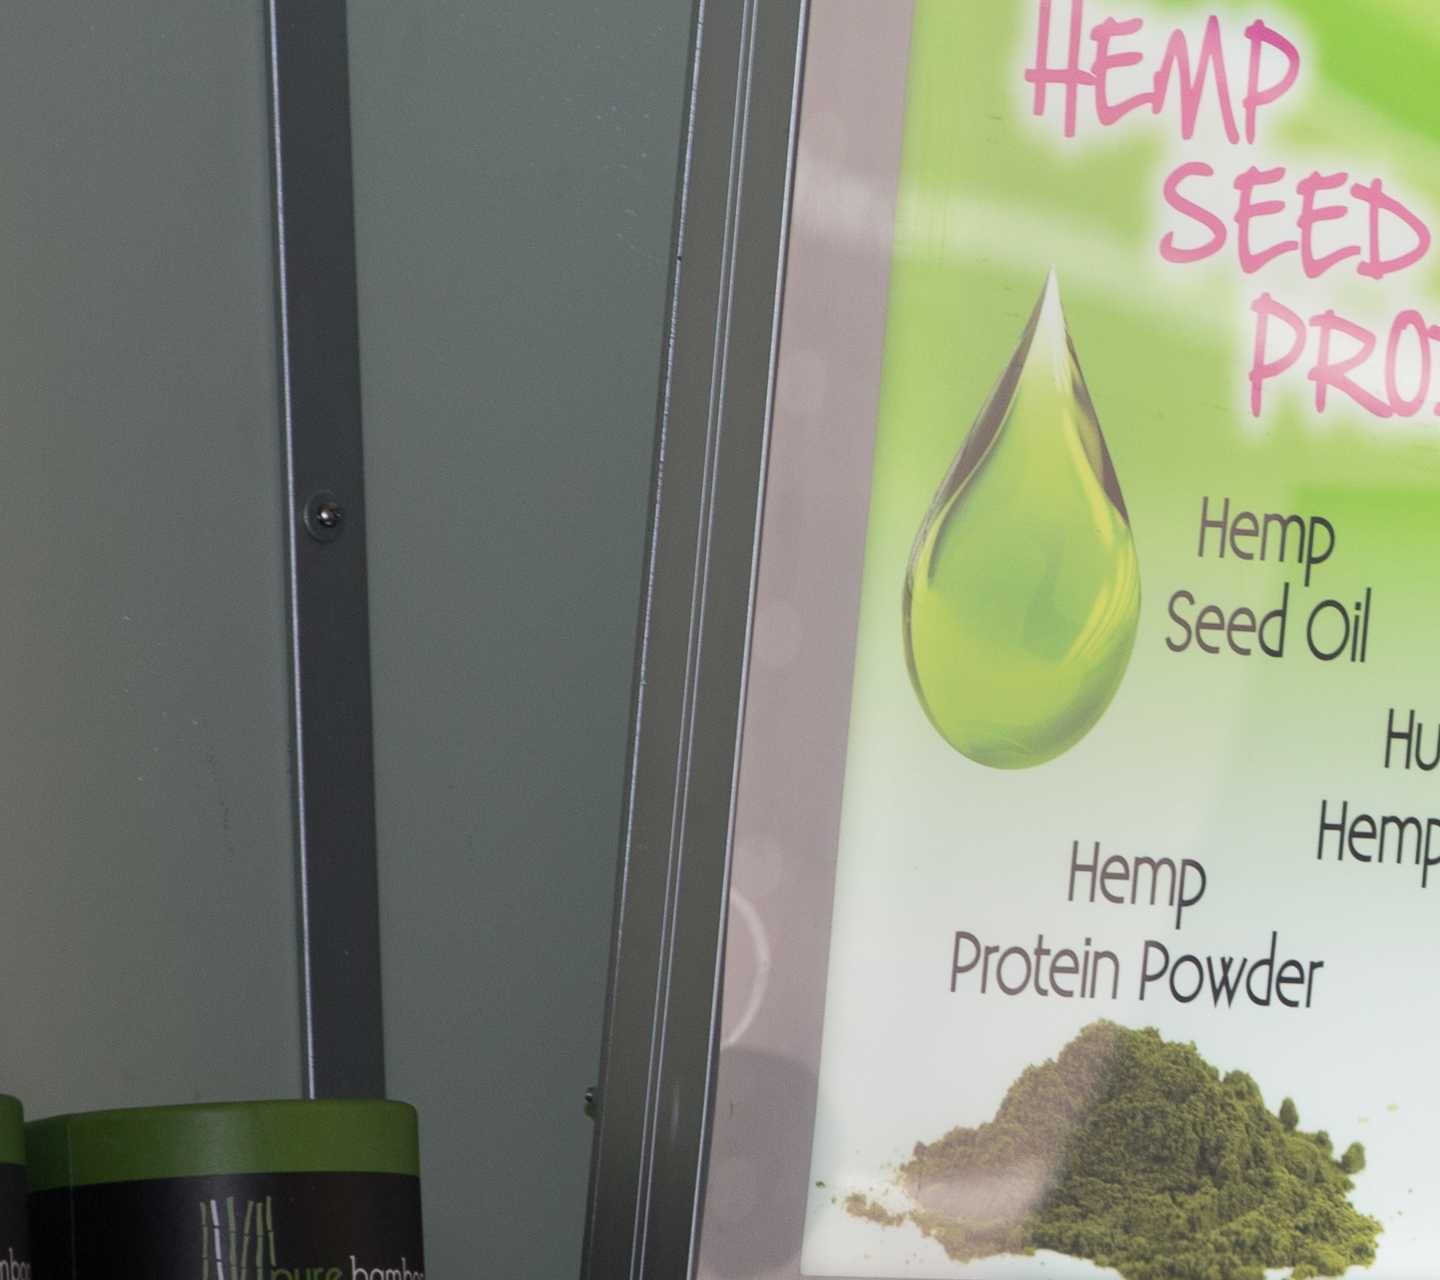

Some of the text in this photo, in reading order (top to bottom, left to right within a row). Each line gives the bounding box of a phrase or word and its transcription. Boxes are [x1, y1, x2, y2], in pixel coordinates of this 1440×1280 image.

[1158, 161, 1432, 280] SEED
[1197, 496, 1336, 587] Hemp
[1166, 582, 1371, 663] Seed Oil
[1068, 840, 1207, 930] Hemp
[949, 930, 1324, 1009] Protein Powder
